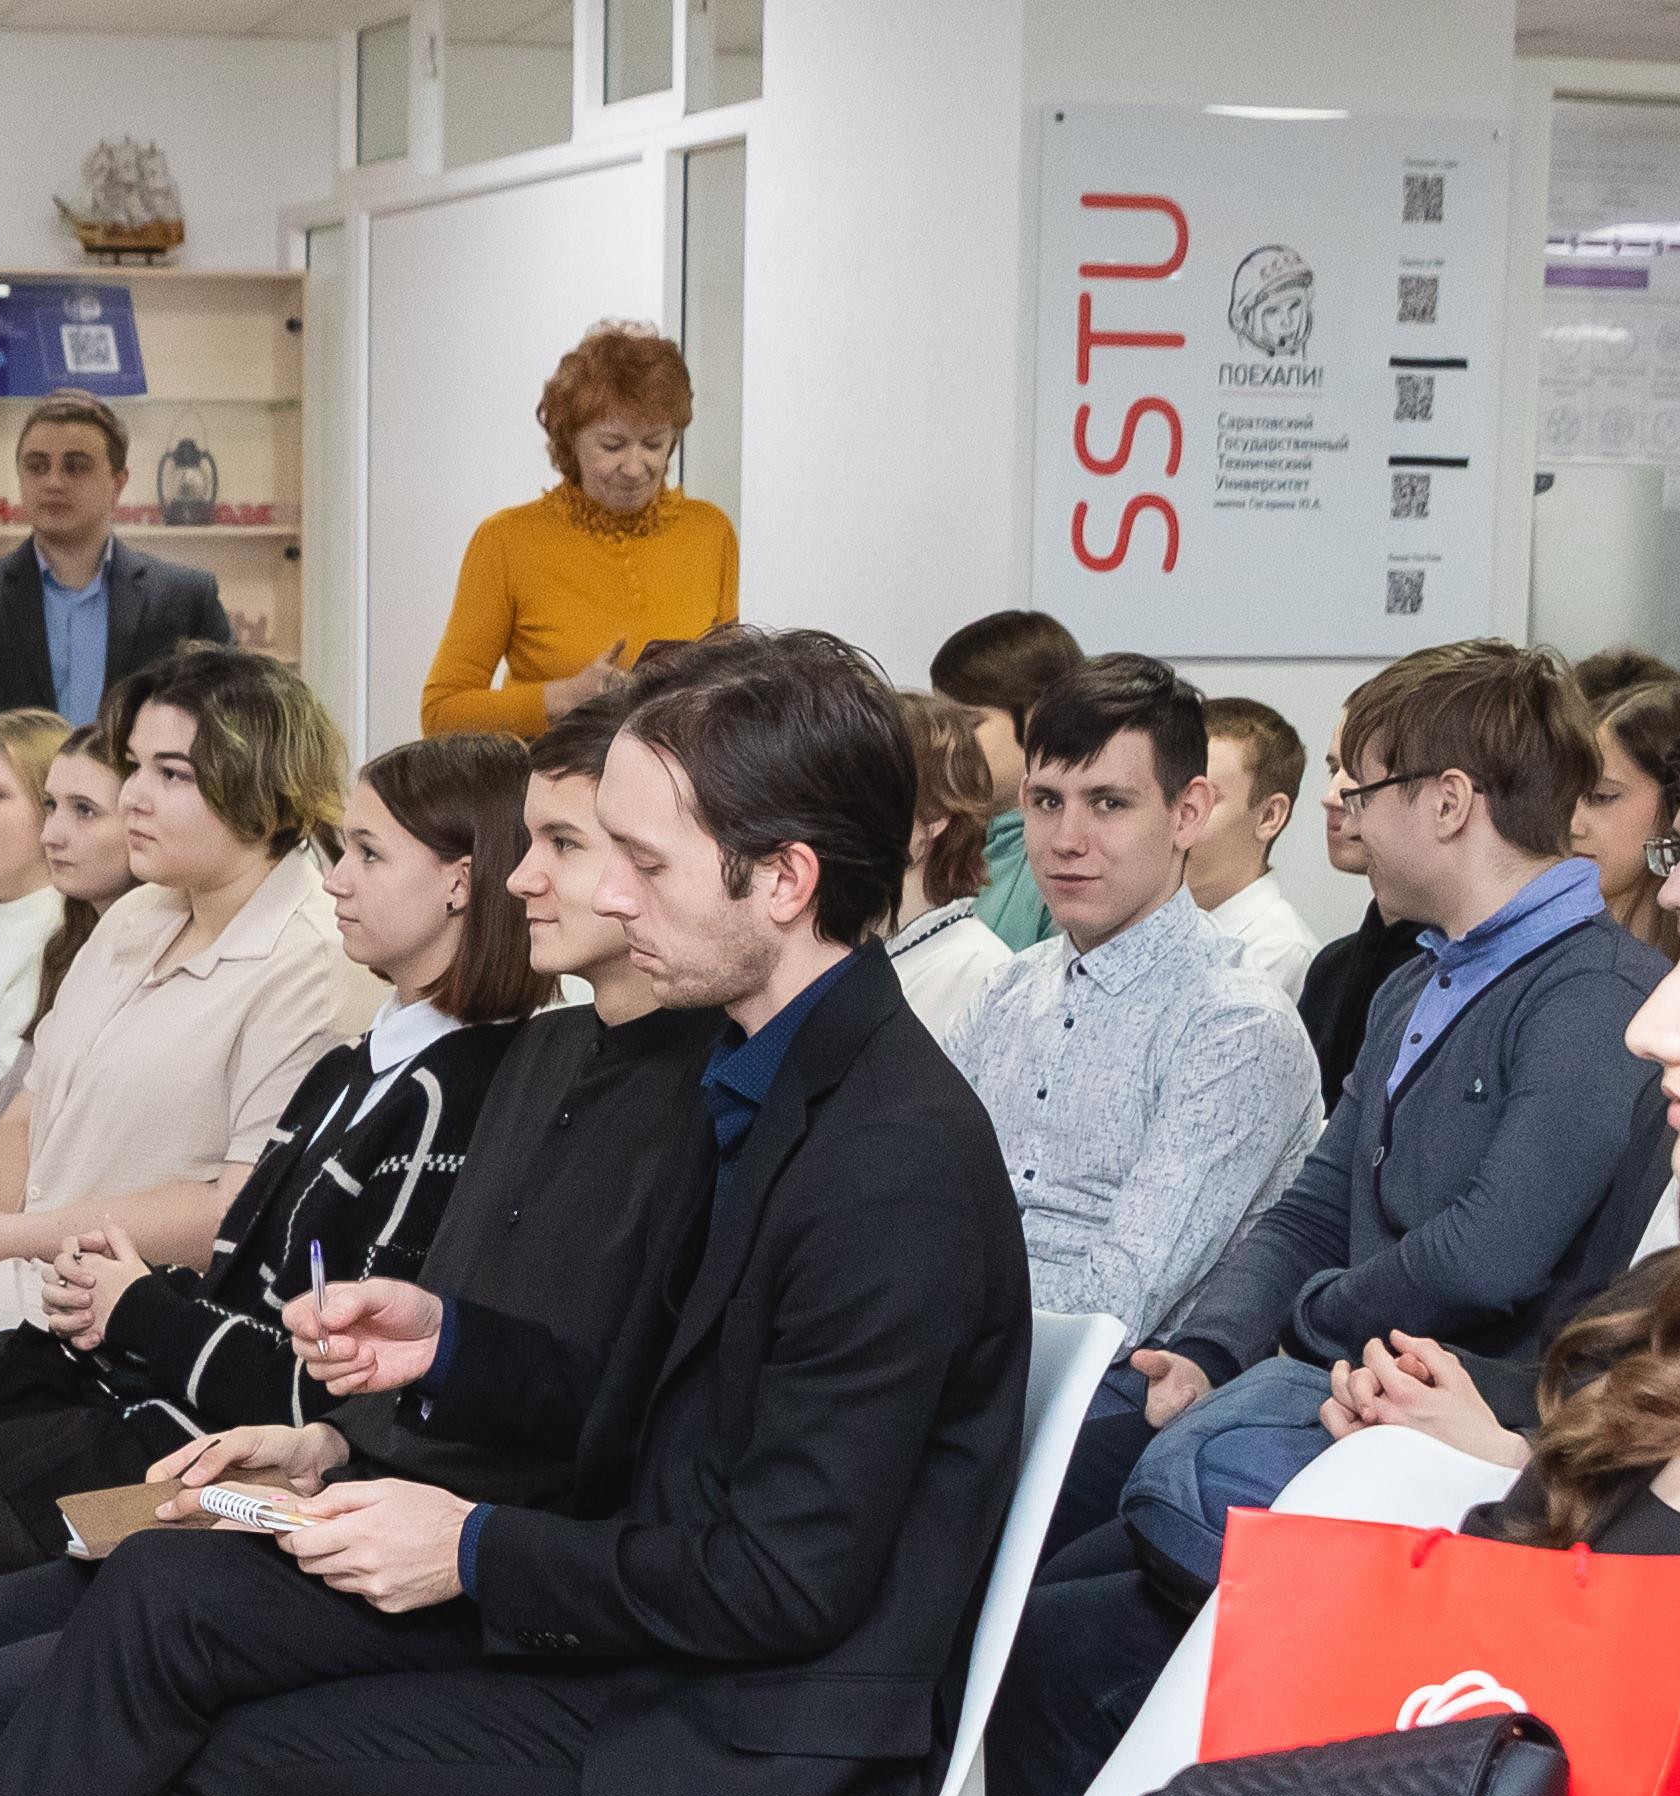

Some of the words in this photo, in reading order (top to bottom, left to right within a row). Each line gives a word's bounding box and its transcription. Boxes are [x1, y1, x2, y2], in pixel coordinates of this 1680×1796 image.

[1071, 191, 1191, 574] SSTU
[1217, 362, 1324, 388] ПОЕХАЛИ!
[1217, 411, 1314, 431] Саратовский
[1216, 431, 1350, 452] Государственный
[1217, 453, 1313, 471] Технический
[1215, 474, 1311, 493] Университет
